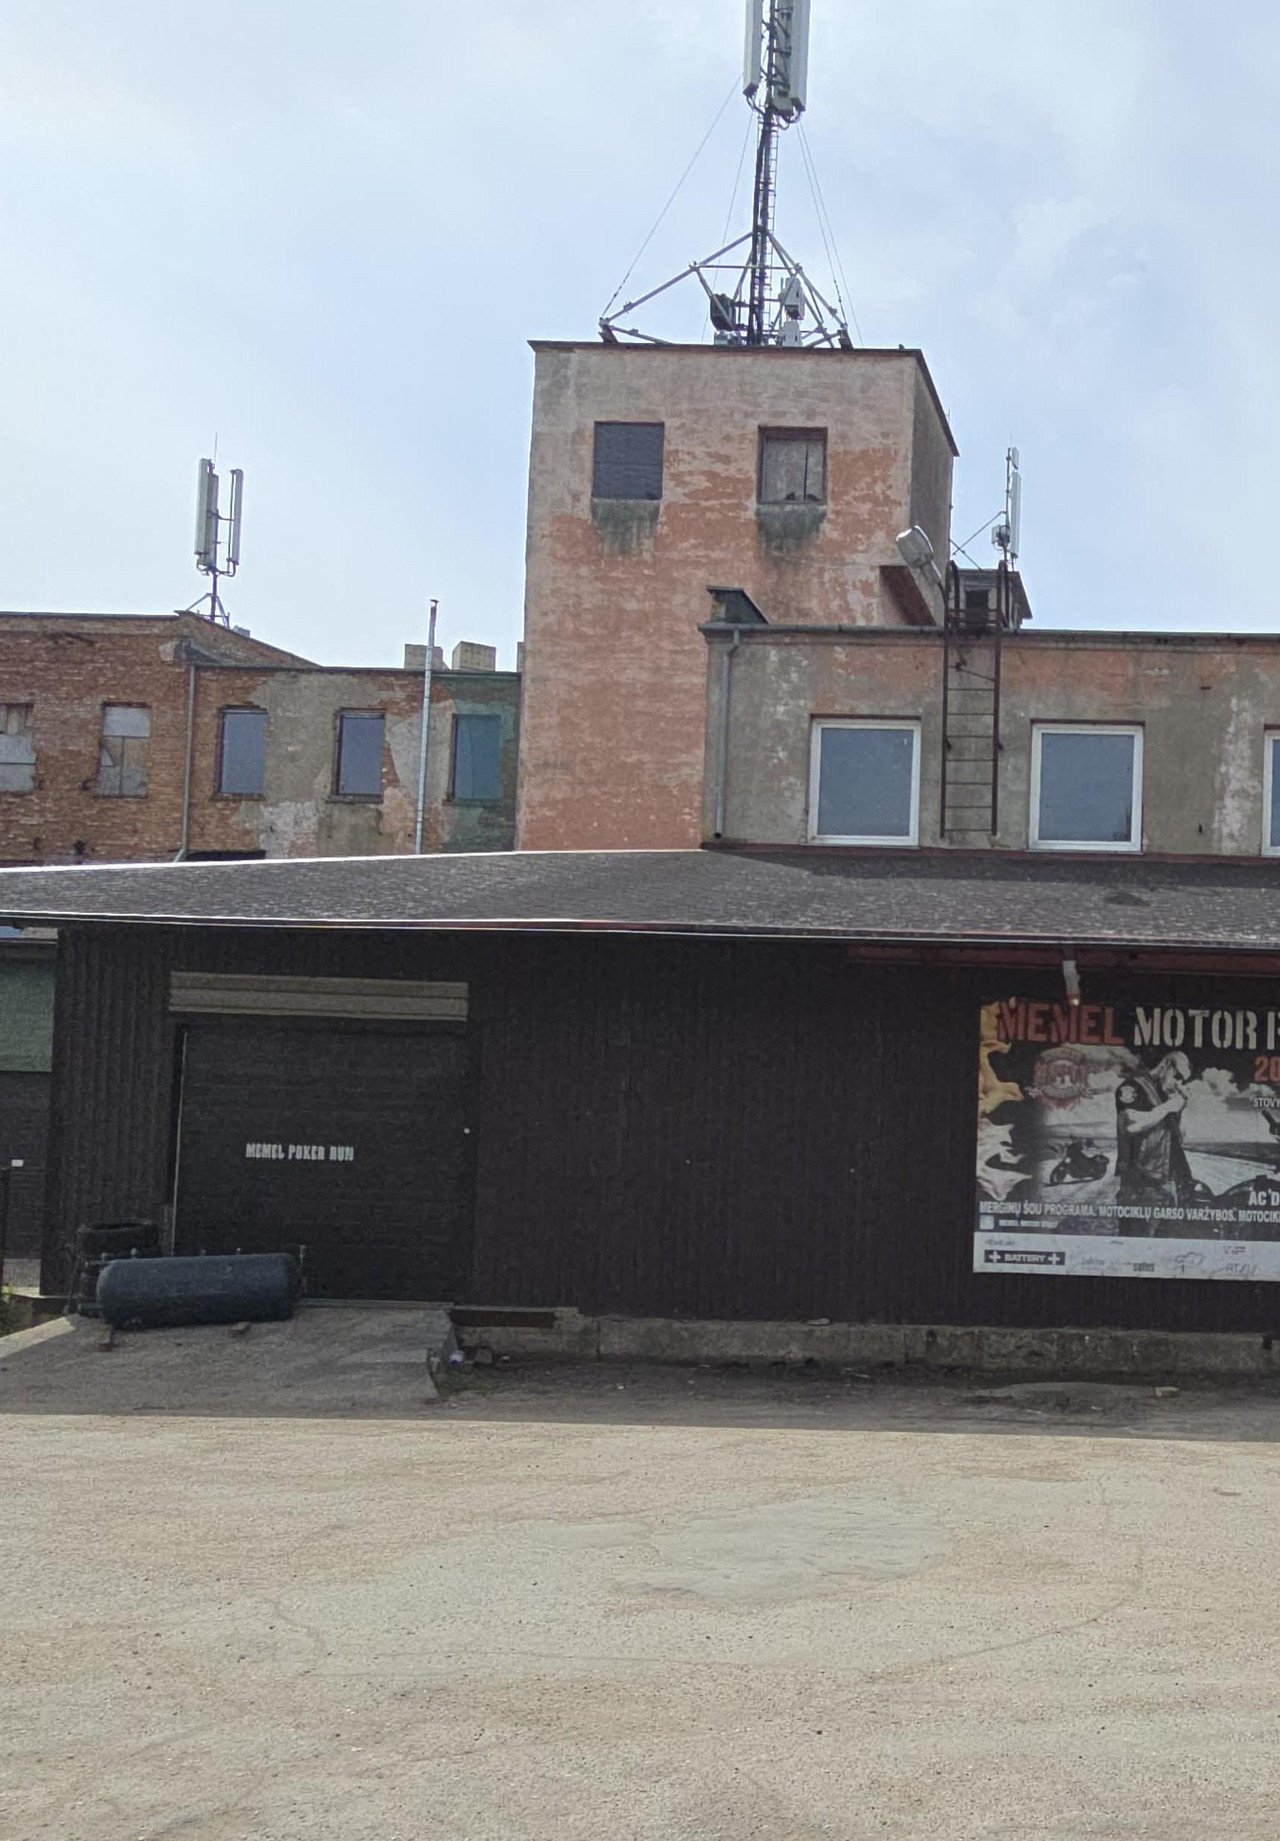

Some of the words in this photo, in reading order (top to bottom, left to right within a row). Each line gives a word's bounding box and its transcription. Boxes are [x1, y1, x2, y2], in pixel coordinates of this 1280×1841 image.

[998, 1001, 1125, 1046] MEMEL
[1133, 1006, 1257, 1049] MOTOR
[245, 1143, 285, 1159] MEMEL
[288, 1144, 325, 1160] POKER
[329, 1146, 354, 1161] RUN
[1153, 1207, 1184, 1219] GARSO
